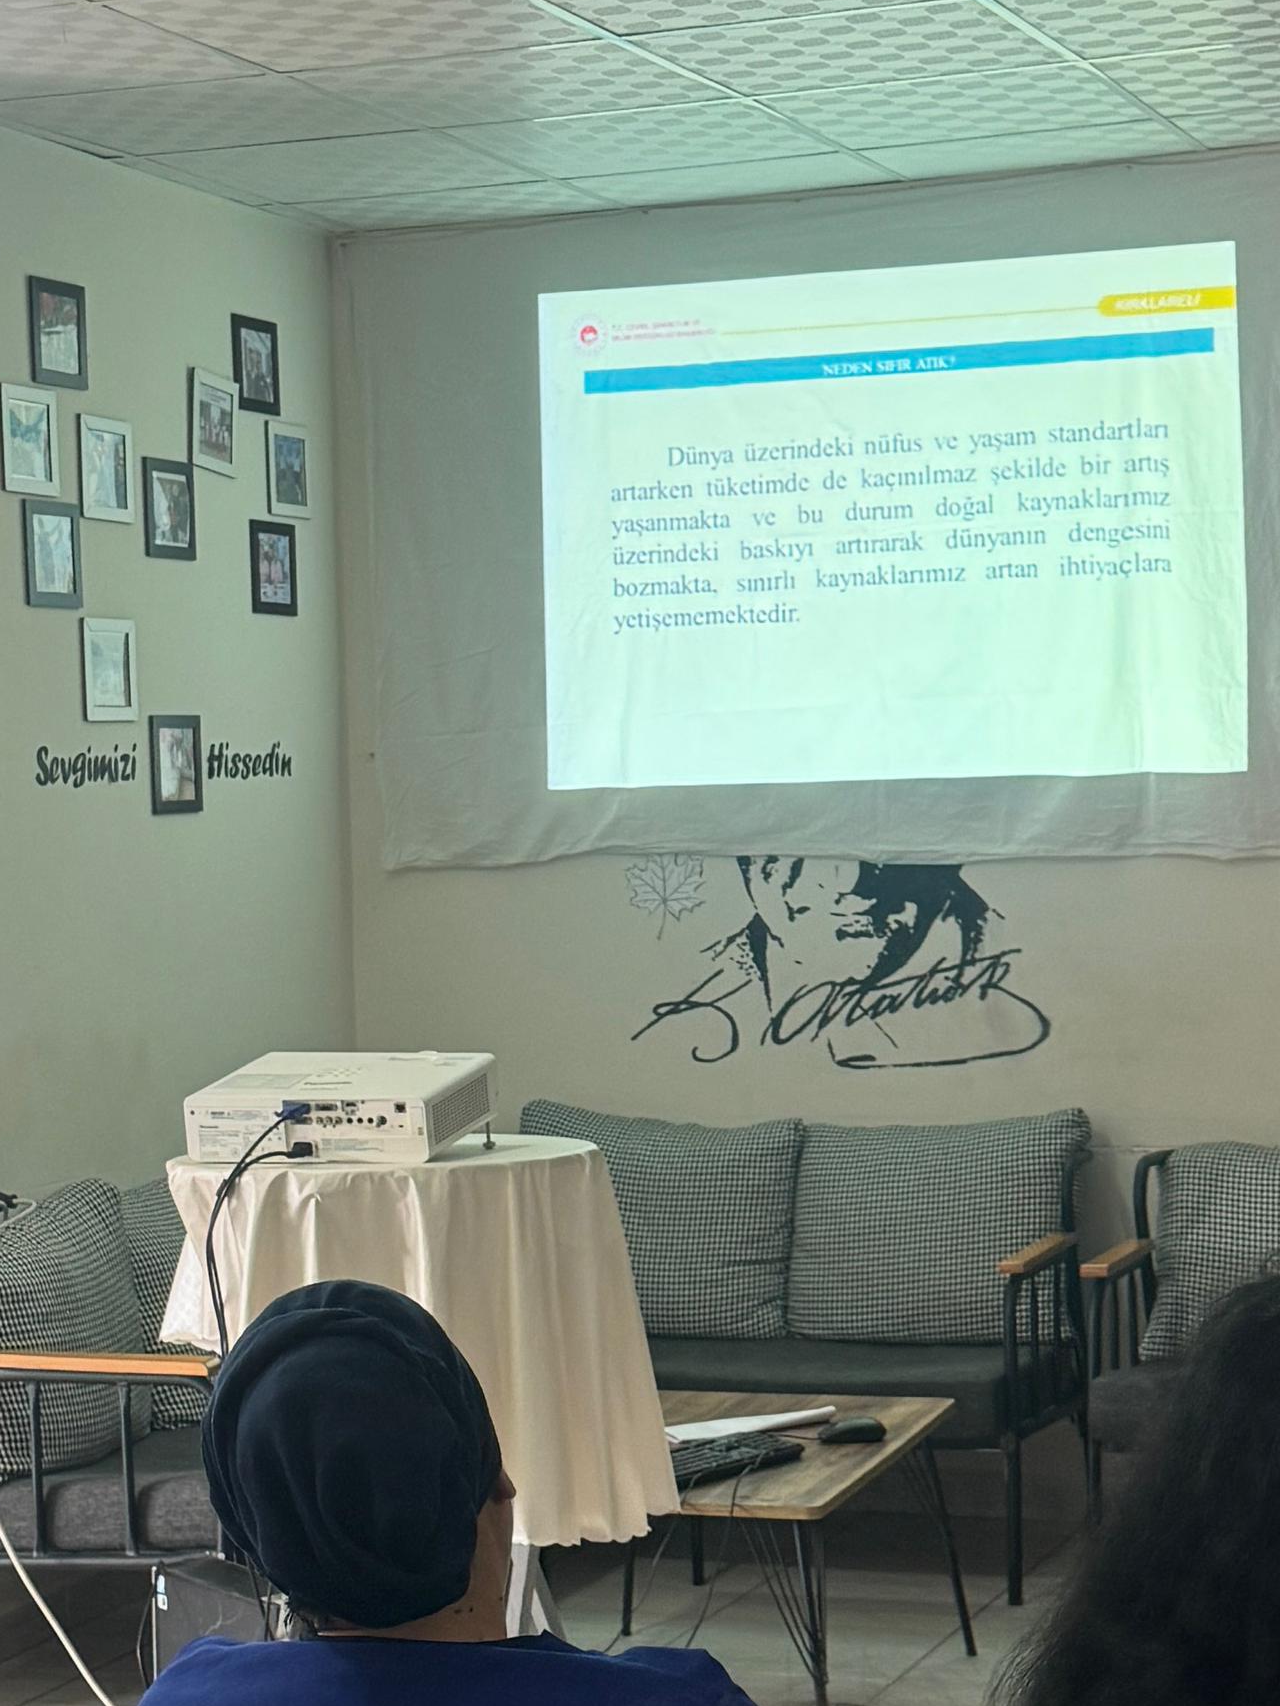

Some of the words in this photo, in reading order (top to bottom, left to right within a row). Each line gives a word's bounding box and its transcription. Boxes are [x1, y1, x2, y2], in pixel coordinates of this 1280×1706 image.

[822, 361, 872, 377] NEDEN
[667, 445, 735, 471] Dünya
[744, 436, 854, 463] üzerindeki
[864, 432, 923, 456] nüfus
[933, 435, 958, 451] ve
[969, 428, 1037, 455] yaşam
[1048, 417, 1169, 444] standartları
[610, 480, 694, 502] artarken
[706, 472, 810, 498] tüketimde
[822, 470, 848, 491] de
[861, 464, 977, 493] kaçınılmaz
[990, 456, 1067, 485] şekilde
[1080, 453, 1111, 475] bir
[1123, 455, 1170, 478] artış
[611, 509, 731, 540] yaşanmakta
[752, 510, 776, 526] ve
[797, 504, 824, 525] bu
[845, 500, 914, 522] durum
[935, 493, 994, 522] doğal
[1017, 487, 1171, 517] kaynaklarımız
[612, 542, 720, 566] üzerindeki
[740, 539, 814, 565] baskıyı
[835, 531, 924, 556] artırarak
[945, 527, 1047, 554] dünyanın
[1068, 518, 1171, 548] dengesini
[613, 574, 719, 598] bozmakta,
[736, 570, 796, 593] sınırlı
[816, 563, 967, 593] kaynaklarımız
[985, 561, 1038, 580] artan
[1060, 551, 1173, 581] ihtiyaçlara
[613, 603, 800, 635] yetişememektedir.
[35, 743, 137, 788] Sevgimizi
[207, 741, 292, 780] Hissedin
